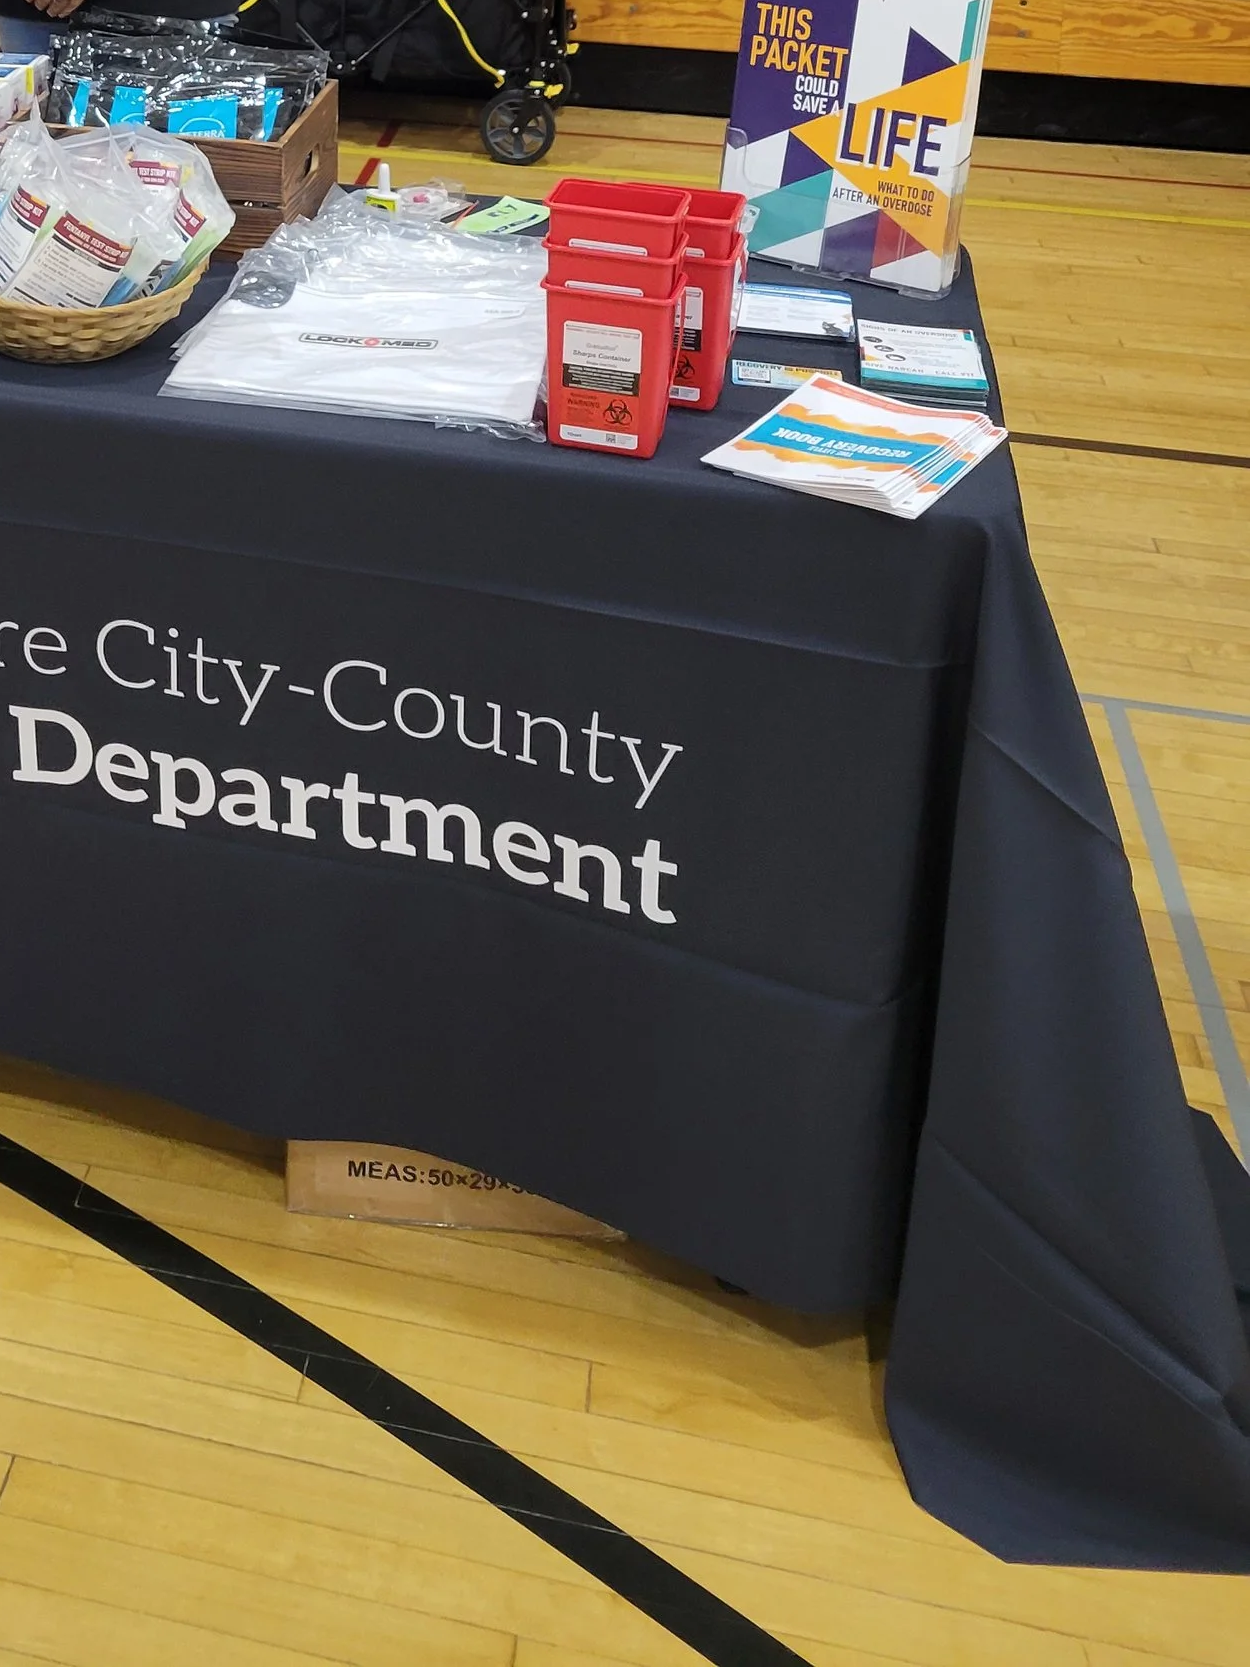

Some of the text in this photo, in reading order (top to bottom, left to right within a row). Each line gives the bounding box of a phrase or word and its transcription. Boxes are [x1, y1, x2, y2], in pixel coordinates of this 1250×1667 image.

[756, 2, 813, 41] THIS
[749, 35, 849, 79] PACKET
[795, 74, 839, 97] COULD
[793, 93, 841, 117] SAVE A
[839, 102, 947, 177] LIFE
[832, 187, 933, 217] AFTER AN OVERDOSE
[877, 180, 935, 202] WHAT TO DO
[63, 220, 93, 243] FENTANYL
[90, 238, 106, 251] TEST
[104, 245, 121, 257] STRIP
[572, 349, 632, 363] Sharps Container
[736, 361, 782, 370] RECOVERY
[888, 365, 924, 374] NARCAN
[772, 427, 912, 458] RECOVERY BOOK
[96, 619, 684, 810] City-County
[8, 704, 678, 924] Department
